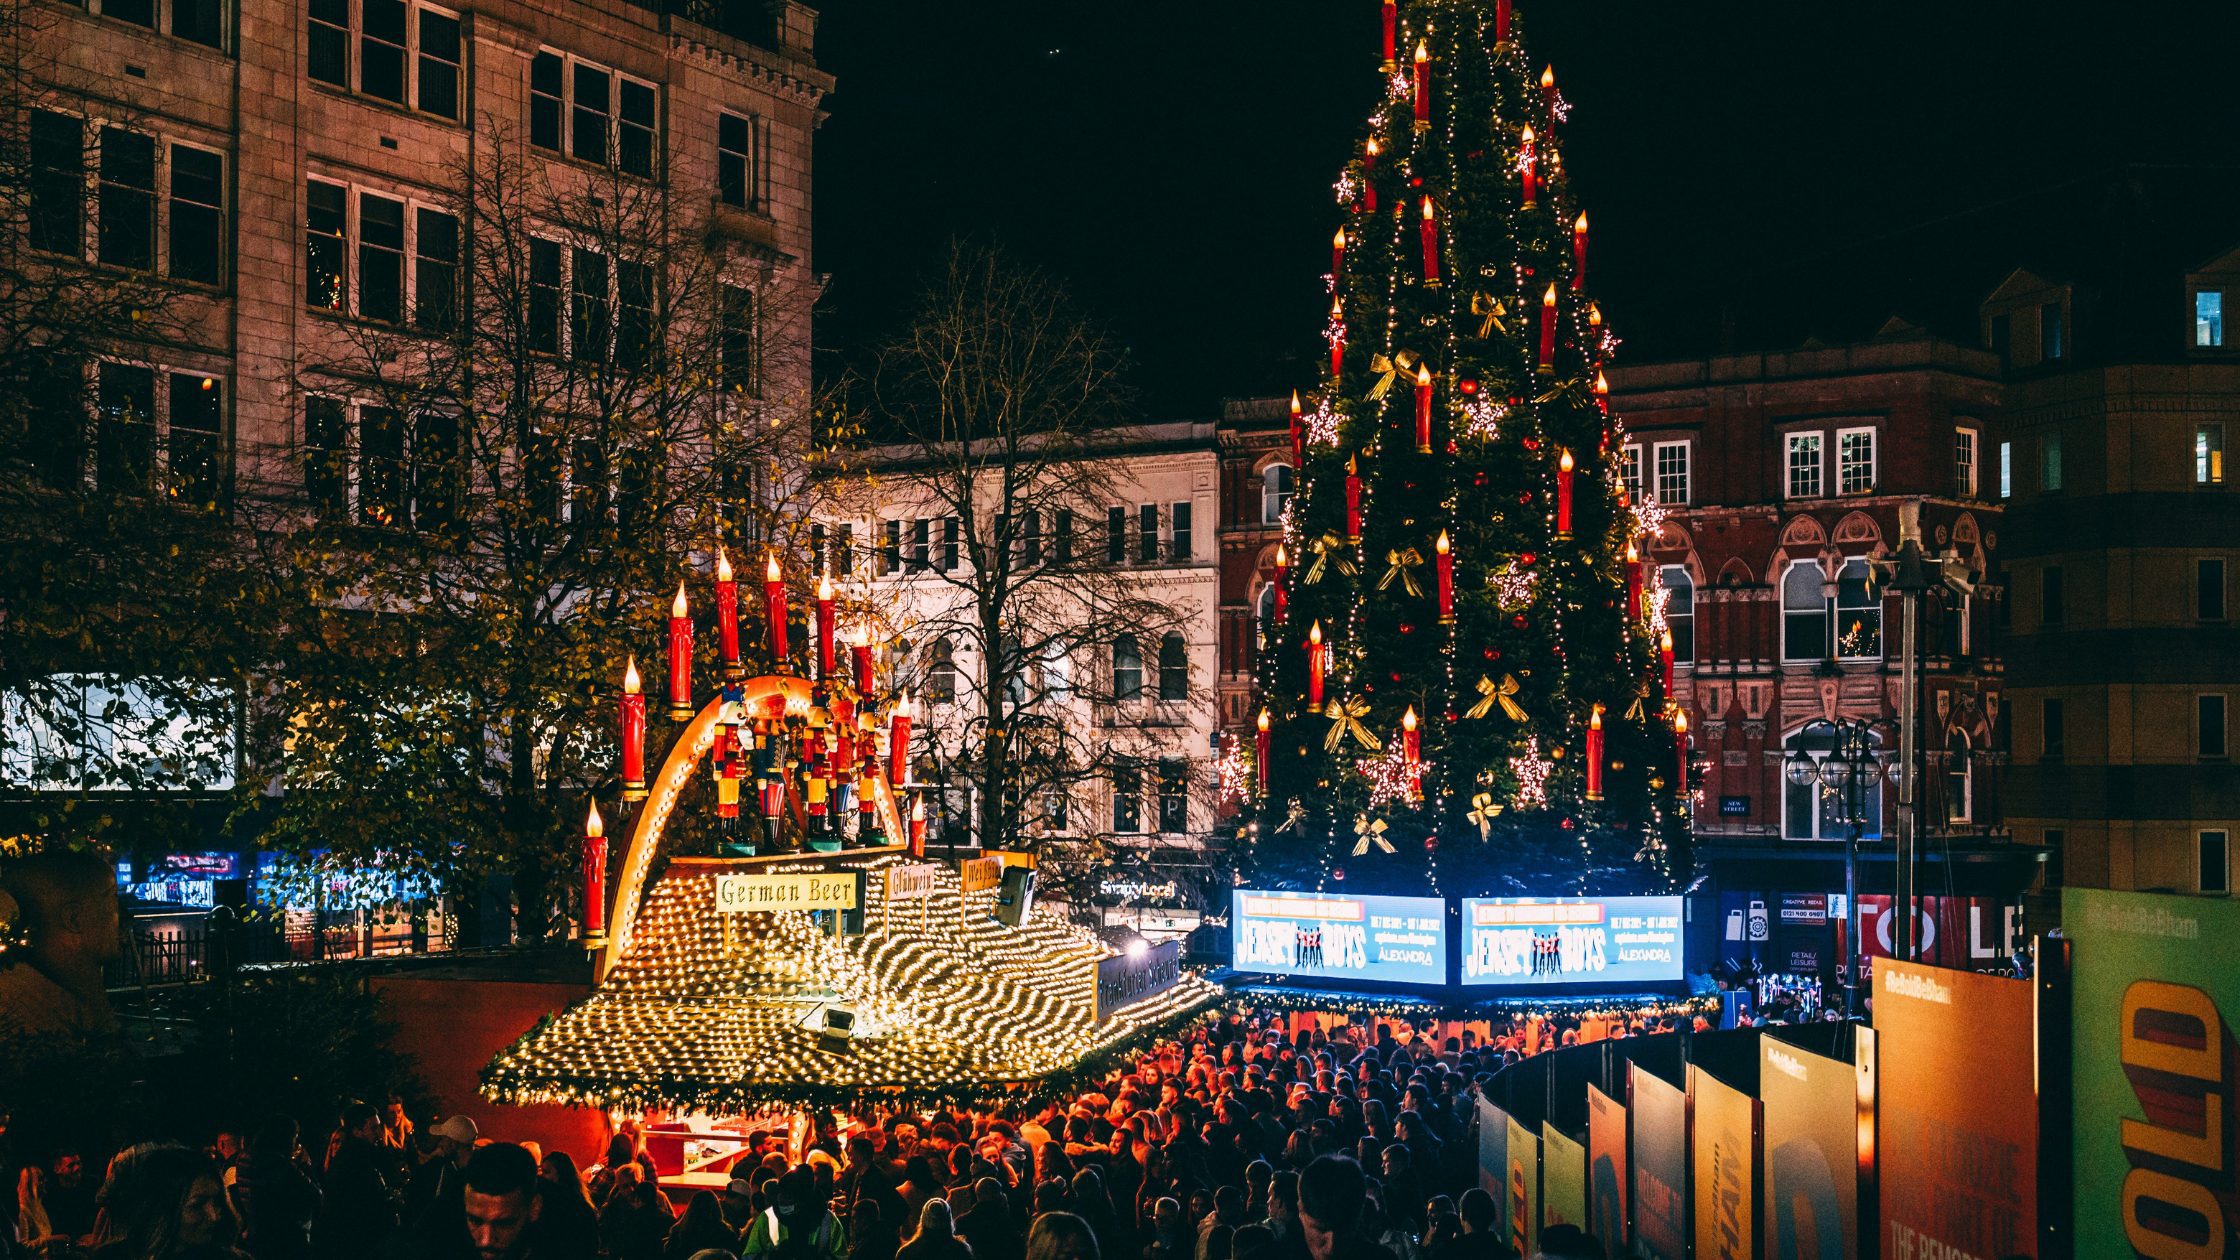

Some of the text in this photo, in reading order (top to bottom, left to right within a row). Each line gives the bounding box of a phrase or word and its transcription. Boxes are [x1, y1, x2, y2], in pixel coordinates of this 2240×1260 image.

[721, 878, 851, 907] German Beer
[893, 868, 931, 896] Glühwein
[1237, 918, 1367, 969] JERSEY BOYS
[1466, 925, 1606, 977] JERSEY BOYS
